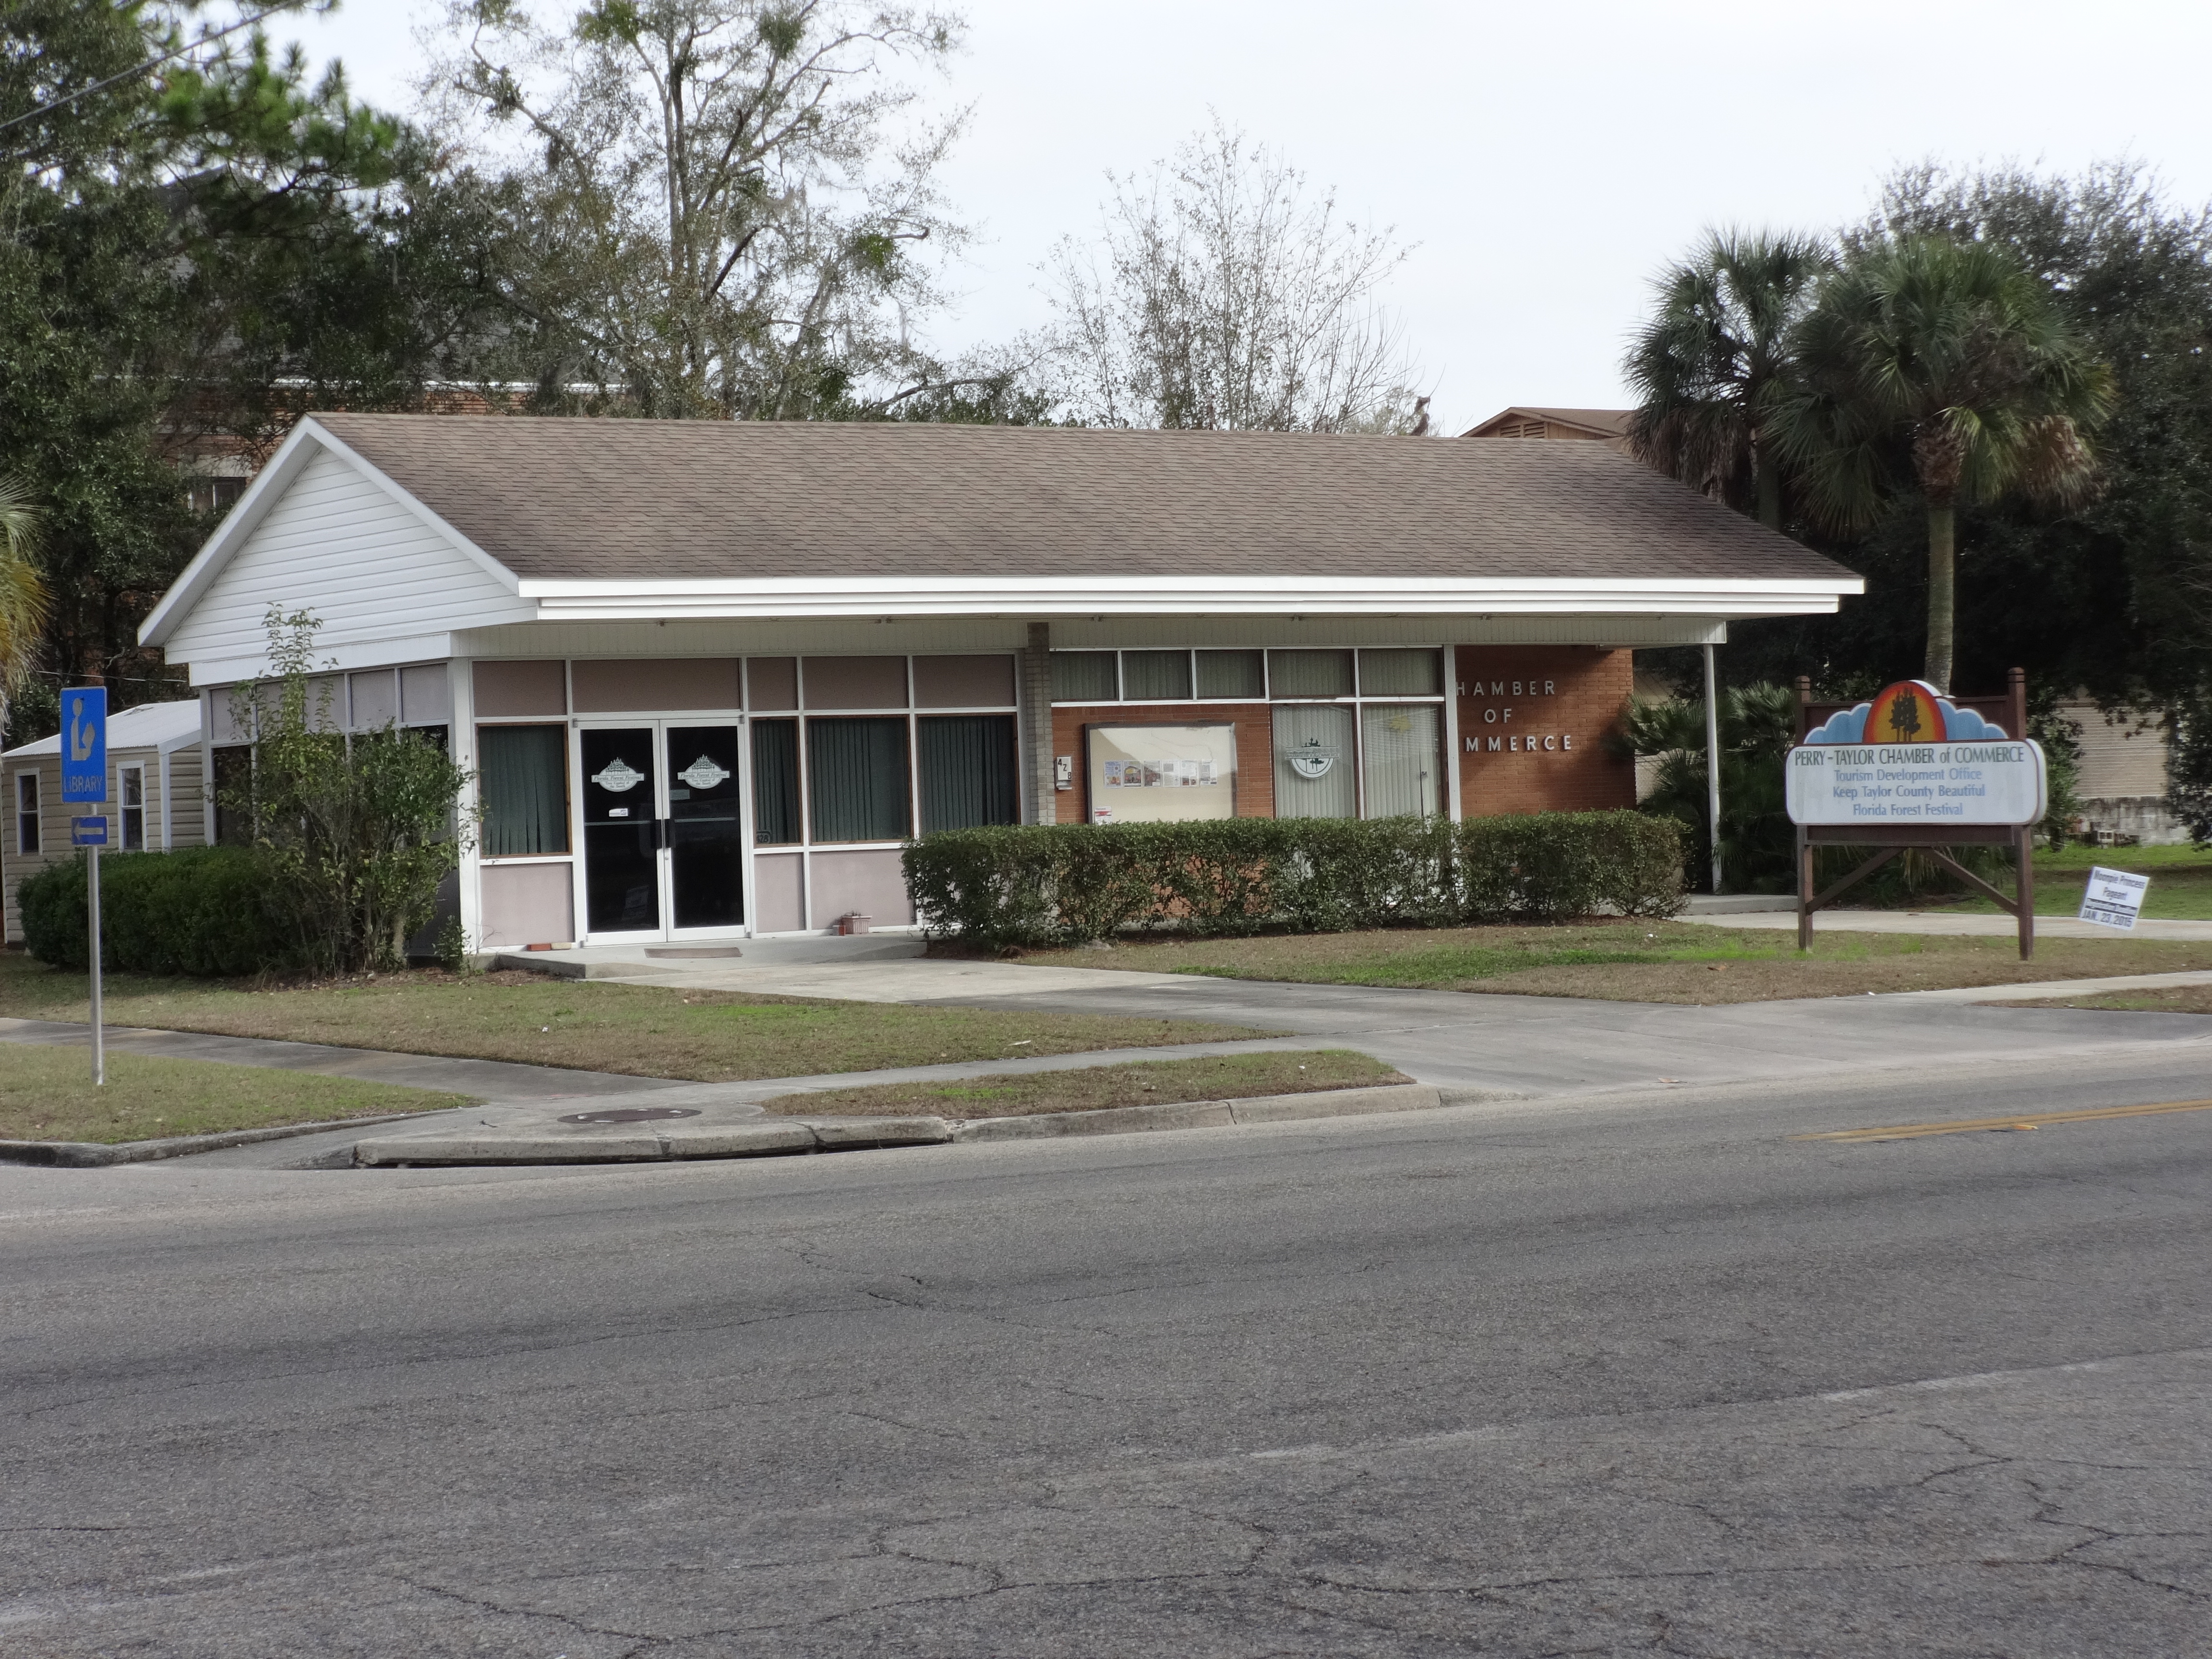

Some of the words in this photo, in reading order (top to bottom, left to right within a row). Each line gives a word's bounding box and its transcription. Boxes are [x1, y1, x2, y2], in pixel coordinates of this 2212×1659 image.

[1455, 680, 1555, 696] HAMBER
[1484, 708, 1512, 723] OF
[1466, 734, 1572, 752] MMERCE
[1879, 748, 1935, 764] CHAMBER
[1939, 746, 1951, 763] of
[1955, 746, 2024, 763] COMMERCE
[1834, 769, 1874, 781] Tourism
[1876, 768, 1945, 783] Development
[1949, 767, 1982, 780] Office
[63, 776, 103, 793] LIBRARY
[1833, 786, 1858, 800] Keep
[1862, 785, 1892, 800] Taylor
[1896, 785, 1934, 800] County
[1938, 784, 1986, 796] Beautiful
[1853, 803, 1887, 816] Florida
[1890, 804, 1921, 816] Forest
[1925, 803, 1963, 815] Festival
[2103, 887, 2128, 900] Pageant
[2081, 909, 2098, 921] JAN.
